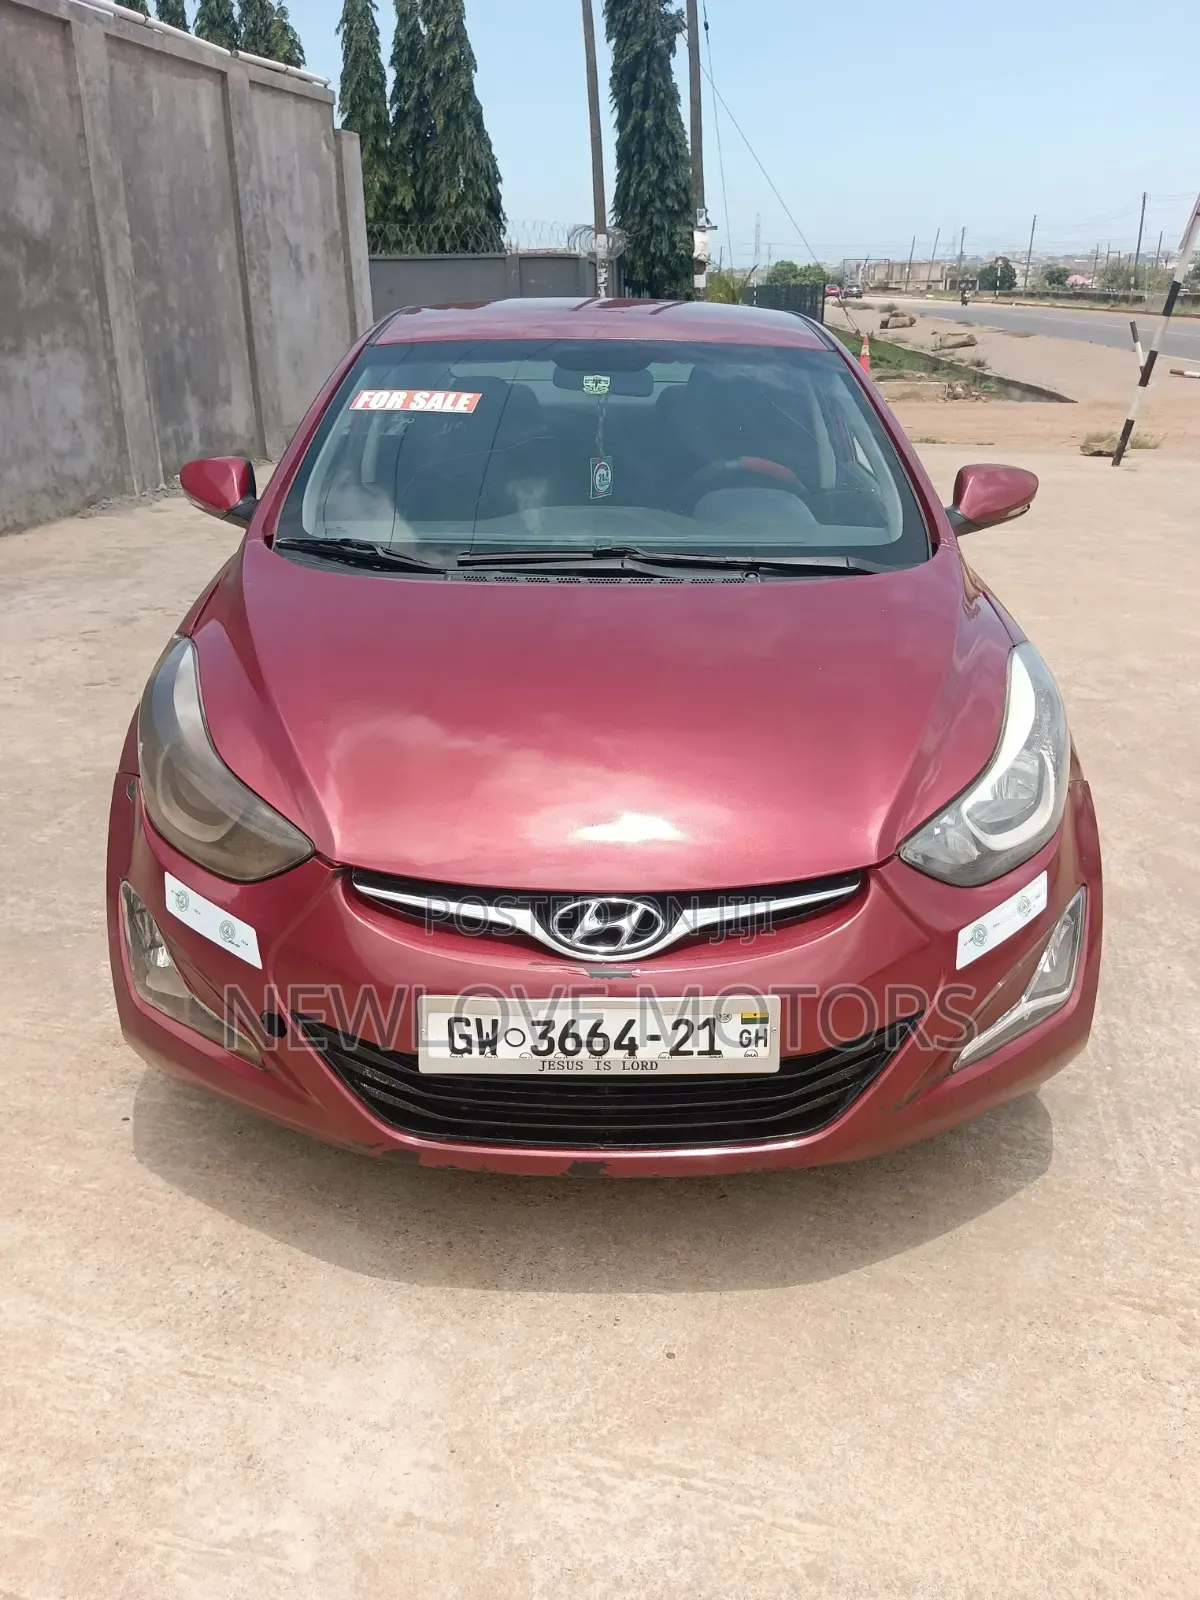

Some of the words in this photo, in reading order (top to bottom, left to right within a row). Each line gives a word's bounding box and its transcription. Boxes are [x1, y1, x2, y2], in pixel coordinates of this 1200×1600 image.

[355, 391, 408, 409] FOR
[409, 391, 474, 411] SALE
[448, 1016, 499, 1056] GW
[529, 1016, 723, 1057] 3664-21
[739, 1028, 768, 1048] GH
[538, 1060, 584, 1072] JESUS
[594, 1060, 612, 1071] IS
[622, 1060, 659, 1071] LORD
